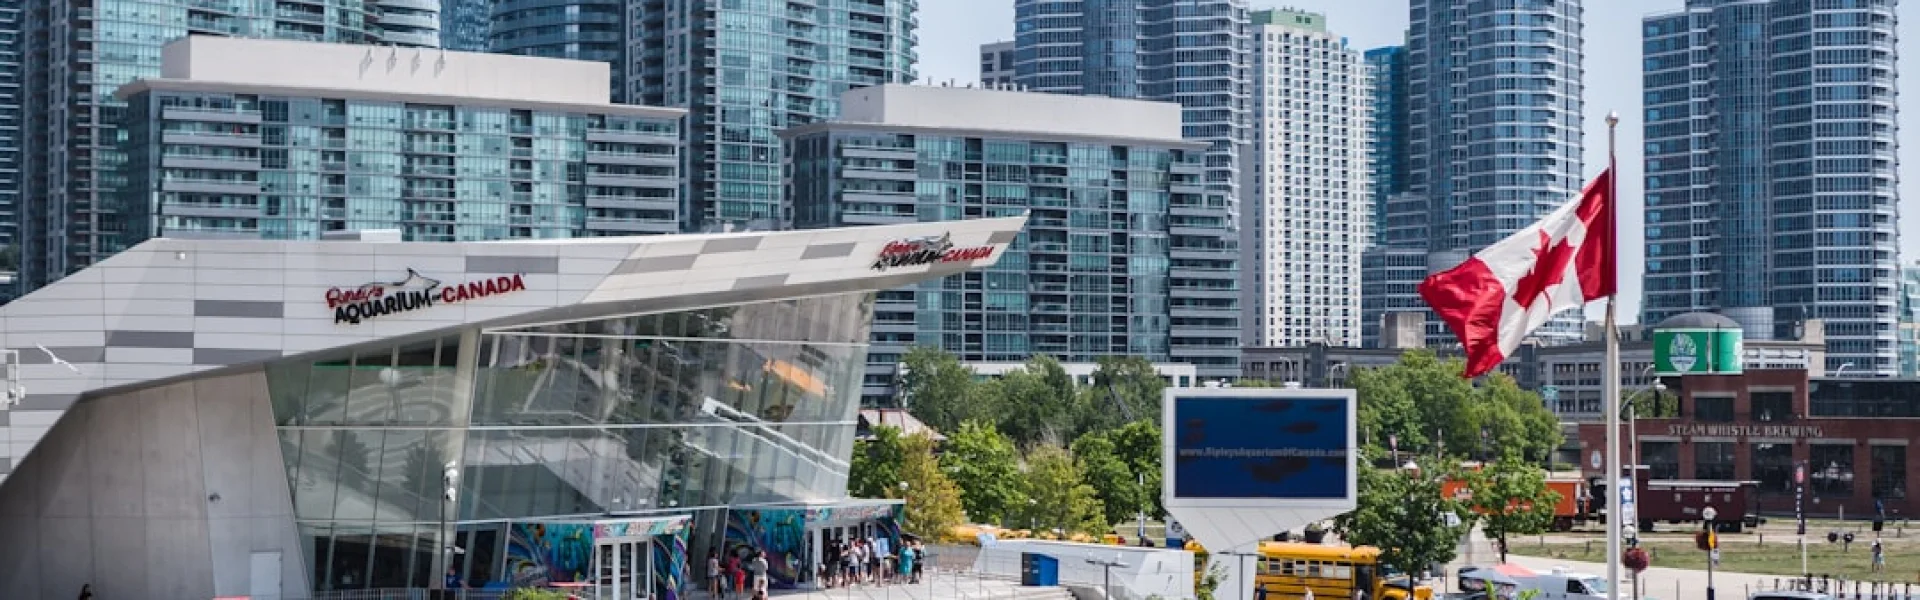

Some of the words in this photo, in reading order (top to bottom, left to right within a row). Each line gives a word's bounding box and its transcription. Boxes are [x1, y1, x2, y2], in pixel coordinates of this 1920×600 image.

[334, 289, 432, 324] AQUARIUM
[441, 274, 526, 303] CANADA
[1668, 424, 1706, 436] STEAM
[1707, 424, 1761, 436] WHISTLE
[1764, 425, 1823, 438] BREWING
